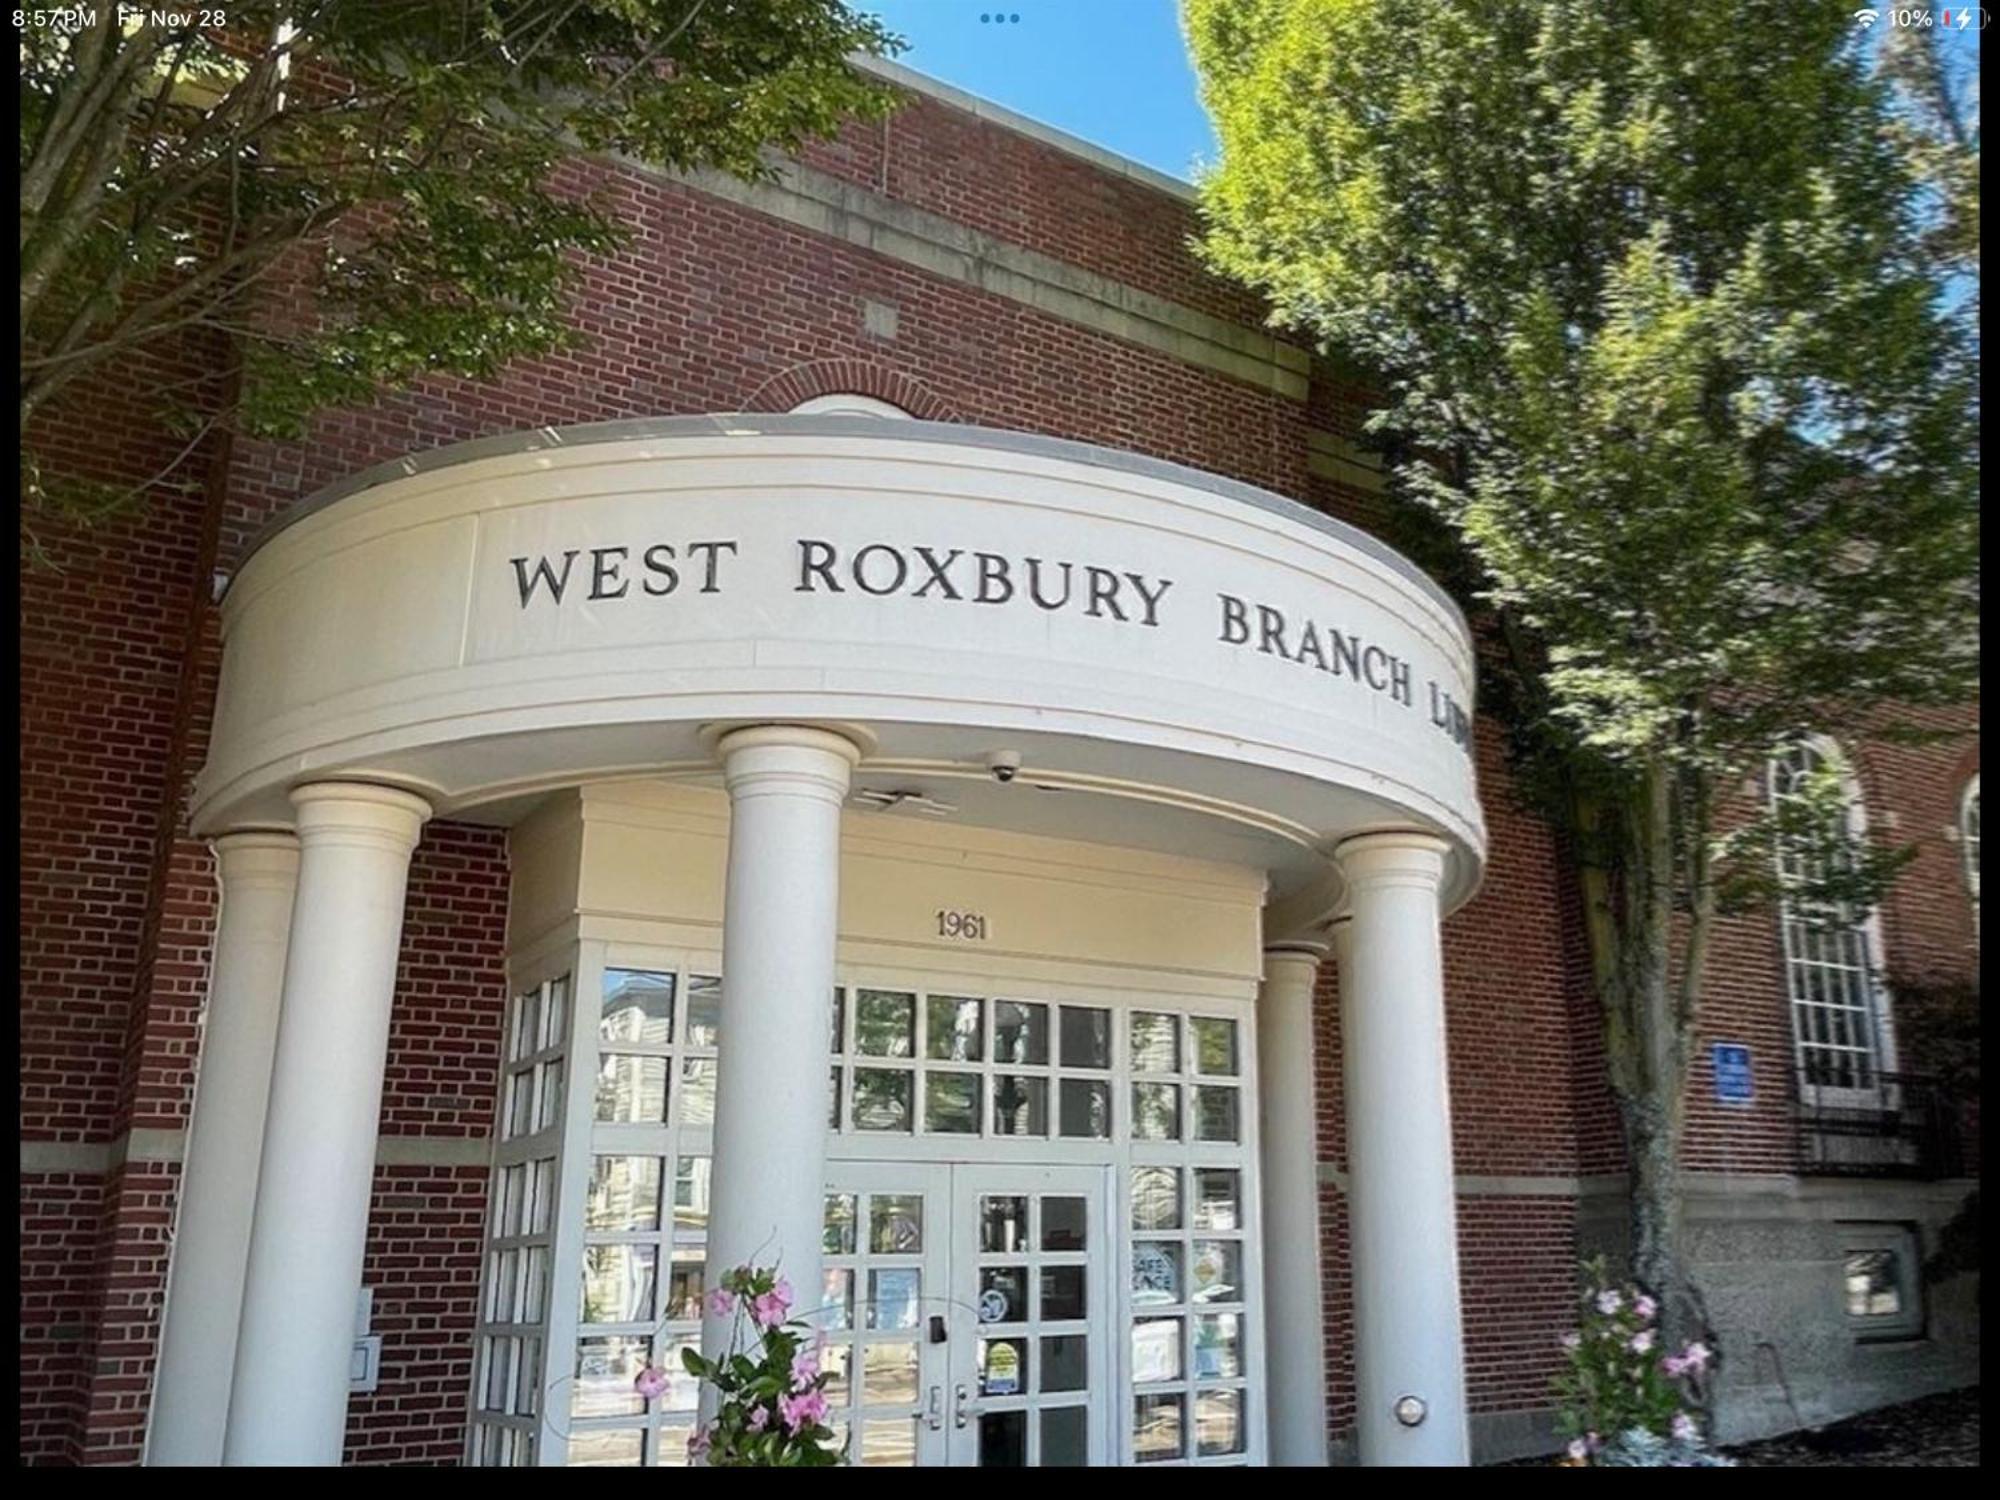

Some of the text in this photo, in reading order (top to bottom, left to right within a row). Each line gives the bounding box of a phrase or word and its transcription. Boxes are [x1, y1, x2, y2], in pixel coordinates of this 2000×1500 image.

[509, 541, 738, 610] WEST
[794, 539, 1173, 627] ROXBURY
[1217, 592, 1412, 708] BRANCH
[936, 910, 986, 940] 1961
